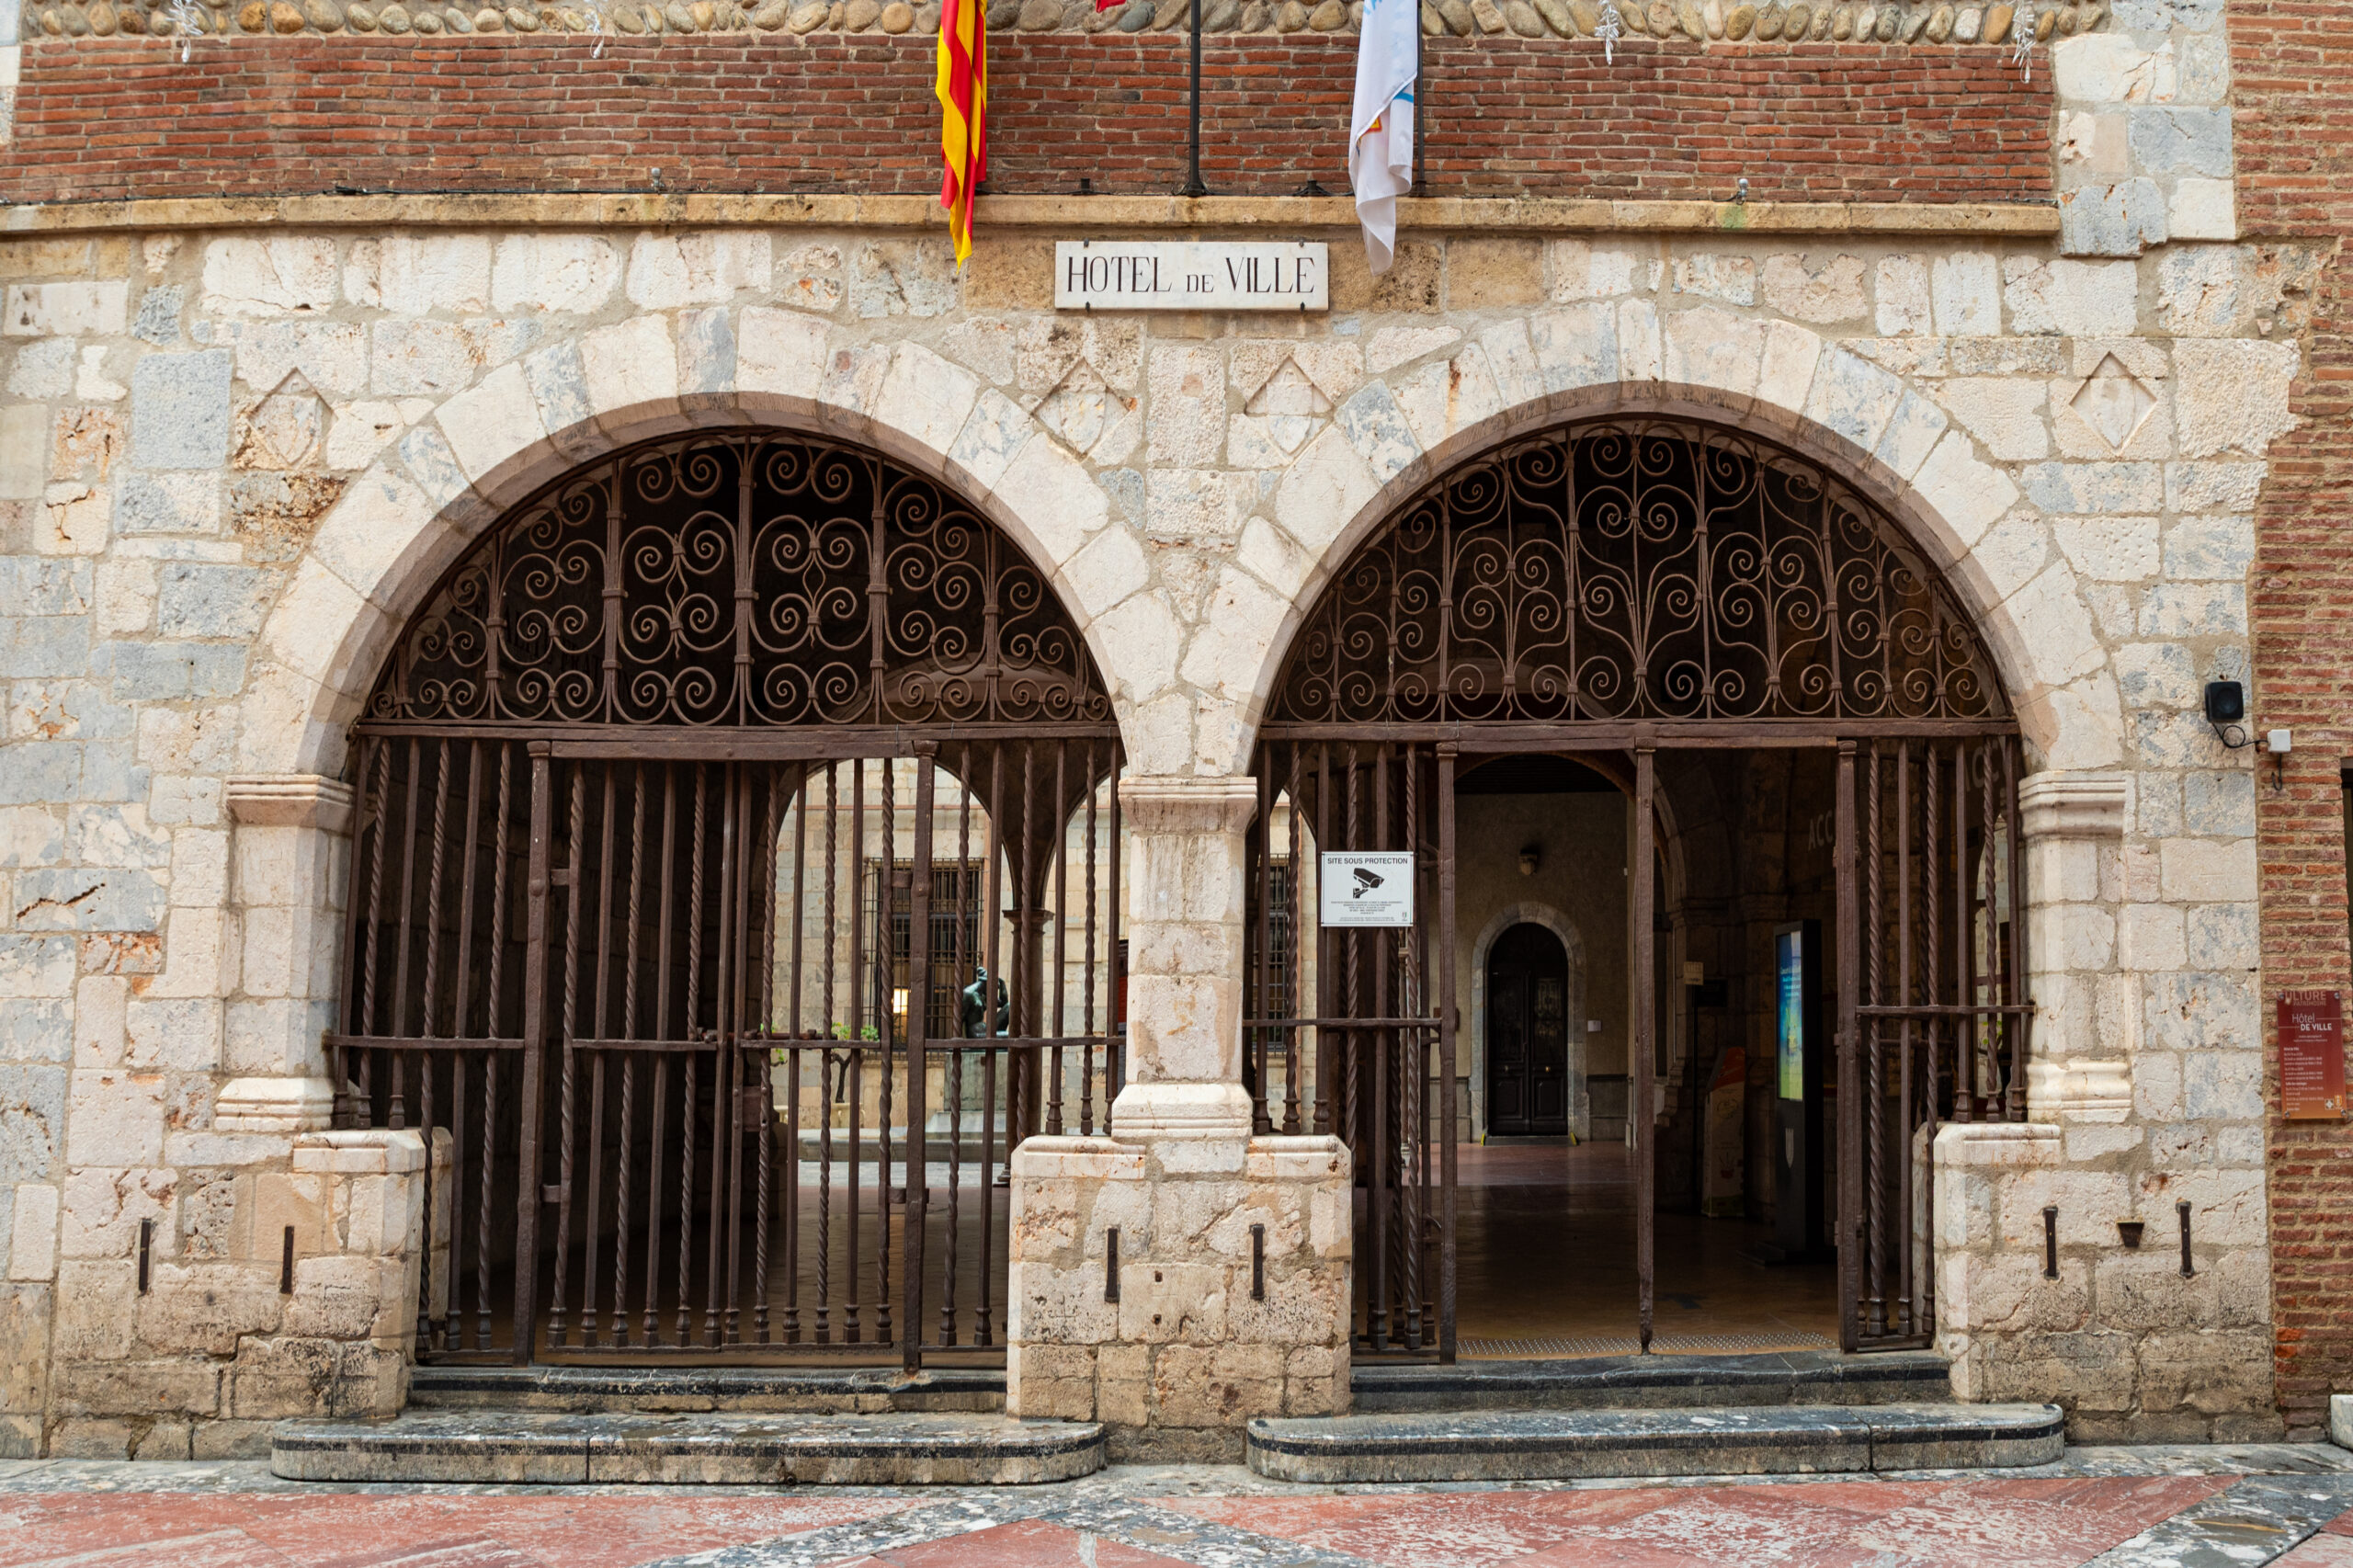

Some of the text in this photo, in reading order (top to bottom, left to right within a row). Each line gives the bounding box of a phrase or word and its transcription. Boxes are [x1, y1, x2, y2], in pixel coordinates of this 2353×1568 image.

[1067, 256, 1315, 293] HOTEL DE VILLE
[2291, 1012, 2315, 1023] Hôtel
[2301, 1023, 2332, 1031] DE VILLE
